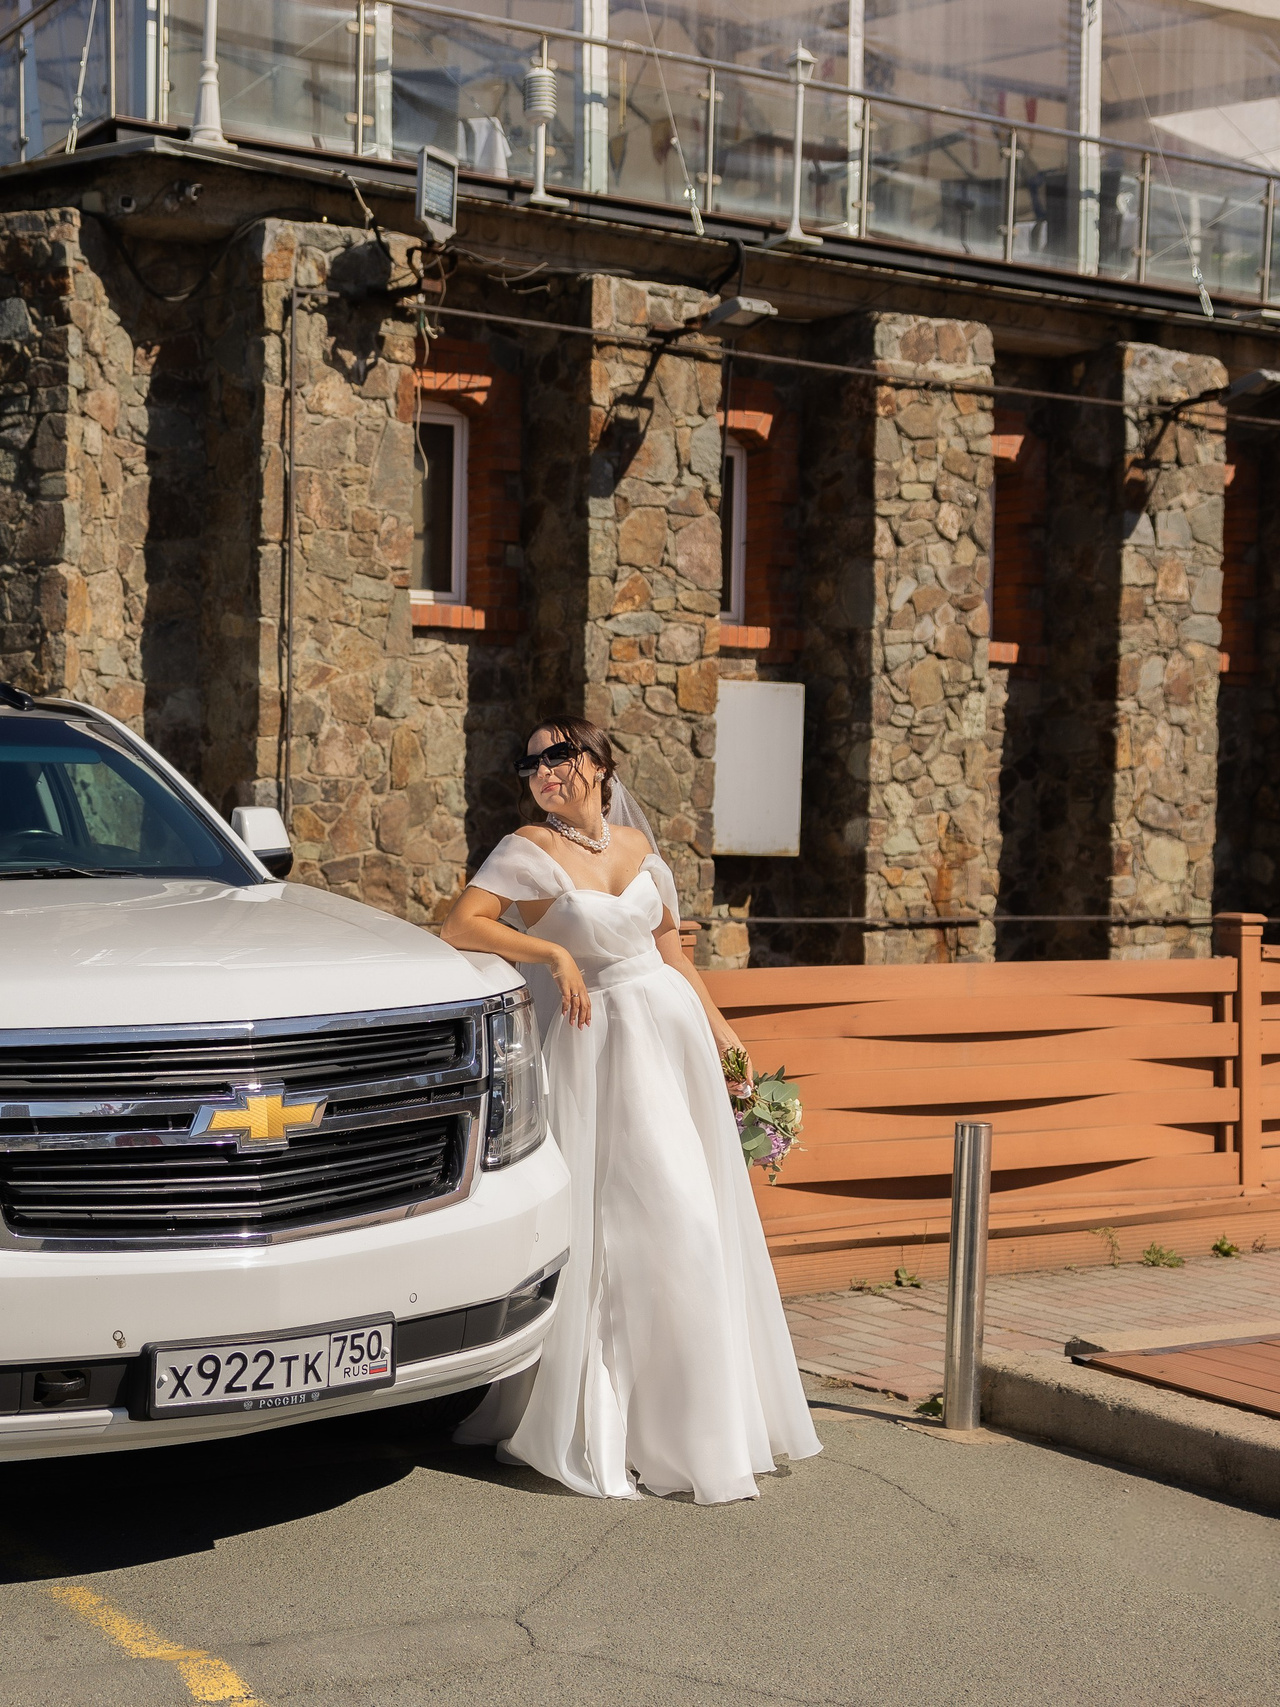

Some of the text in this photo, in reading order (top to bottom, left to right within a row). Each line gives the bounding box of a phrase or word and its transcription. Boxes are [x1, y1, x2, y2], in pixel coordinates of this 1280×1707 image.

[332, 1330, 383, 1368] 750
[343, 1363, 369, 1379] RUS
[258, 1393, 307, 1409] РОССИЯ
